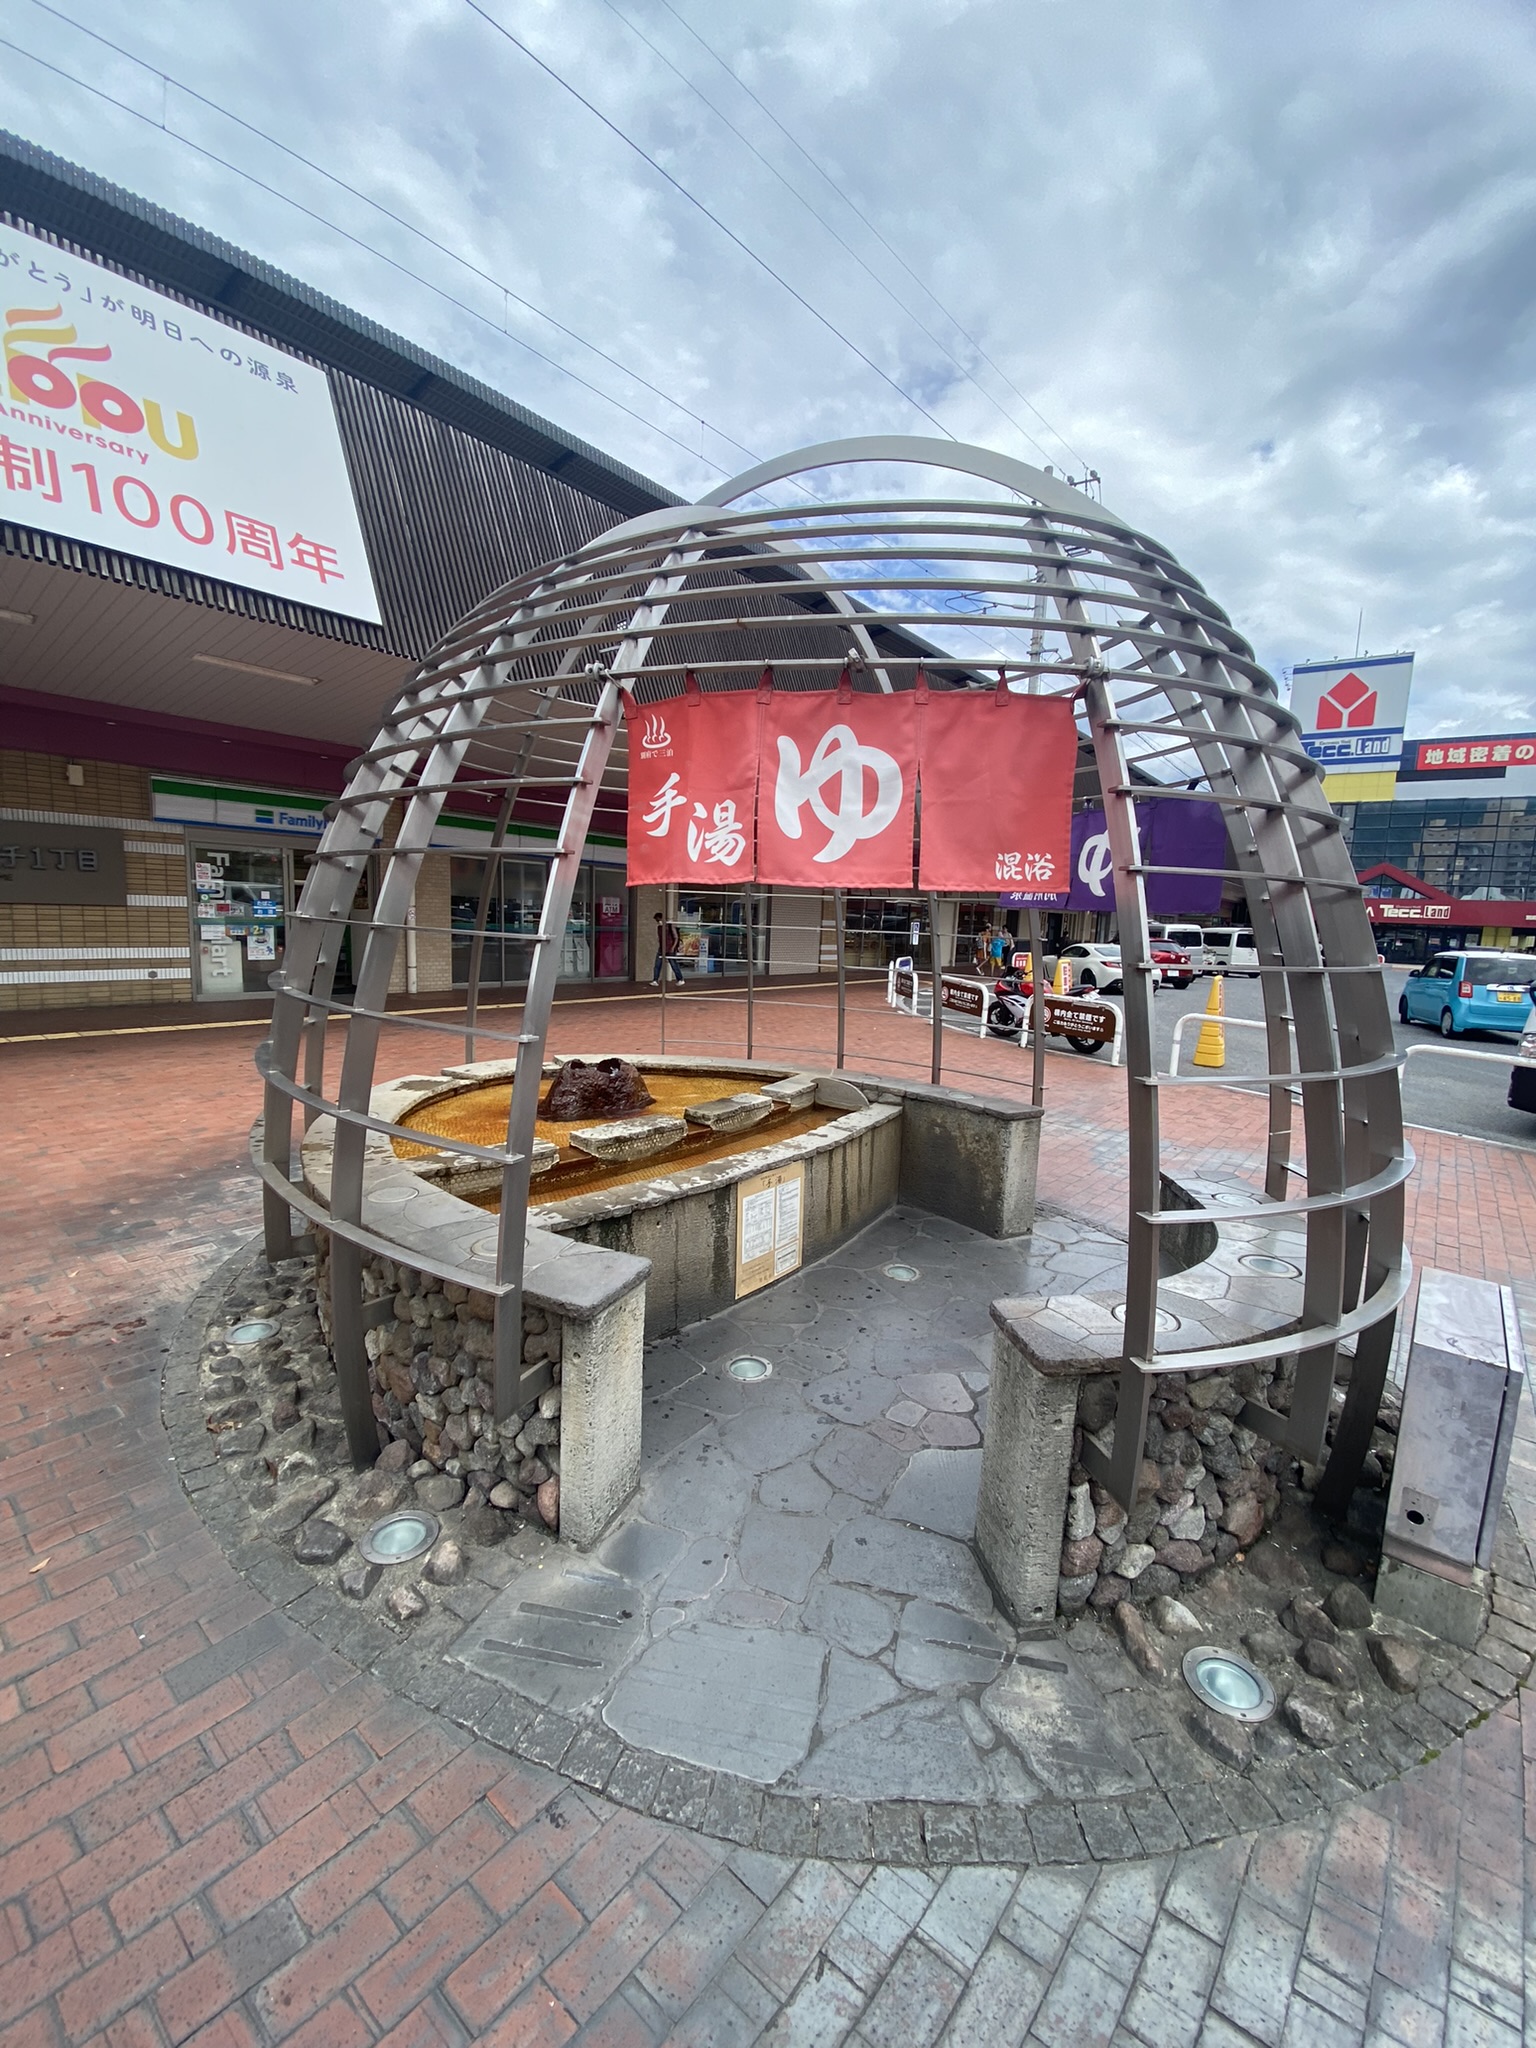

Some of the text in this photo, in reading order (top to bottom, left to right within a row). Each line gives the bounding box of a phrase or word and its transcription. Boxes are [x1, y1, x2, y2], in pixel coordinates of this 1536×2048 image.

[1424, 744, 1535, 766] 地域密着の
[775, 723, 904, 864] ゆ
[279, 811, 328, 830] Family
[642, 771, 747, 867] 手湯
[994, 851, 1056, 882] 混浴
